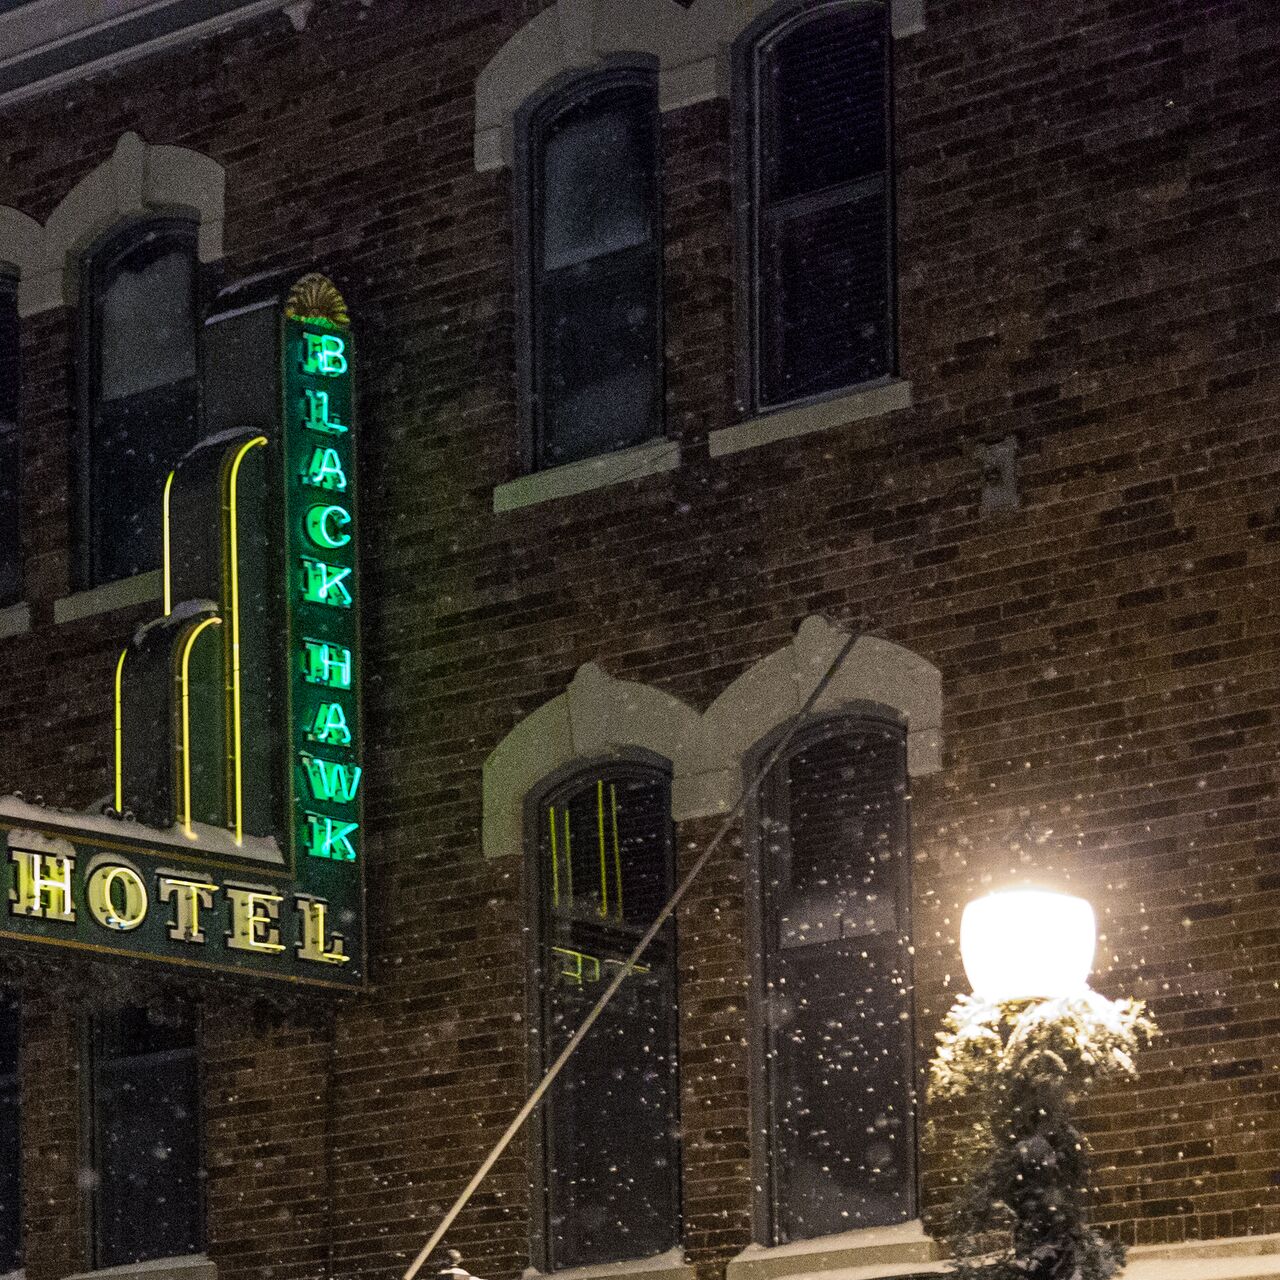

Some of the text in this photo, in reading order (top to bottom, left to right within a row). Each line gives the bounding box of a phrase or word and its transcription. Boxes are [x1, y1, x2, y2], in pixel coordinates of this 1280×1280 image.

[300, 332, 352, 609] BLACK
[300, 638, 362, 863] HAWK
[8, 848, 350, 965] HOTEL
